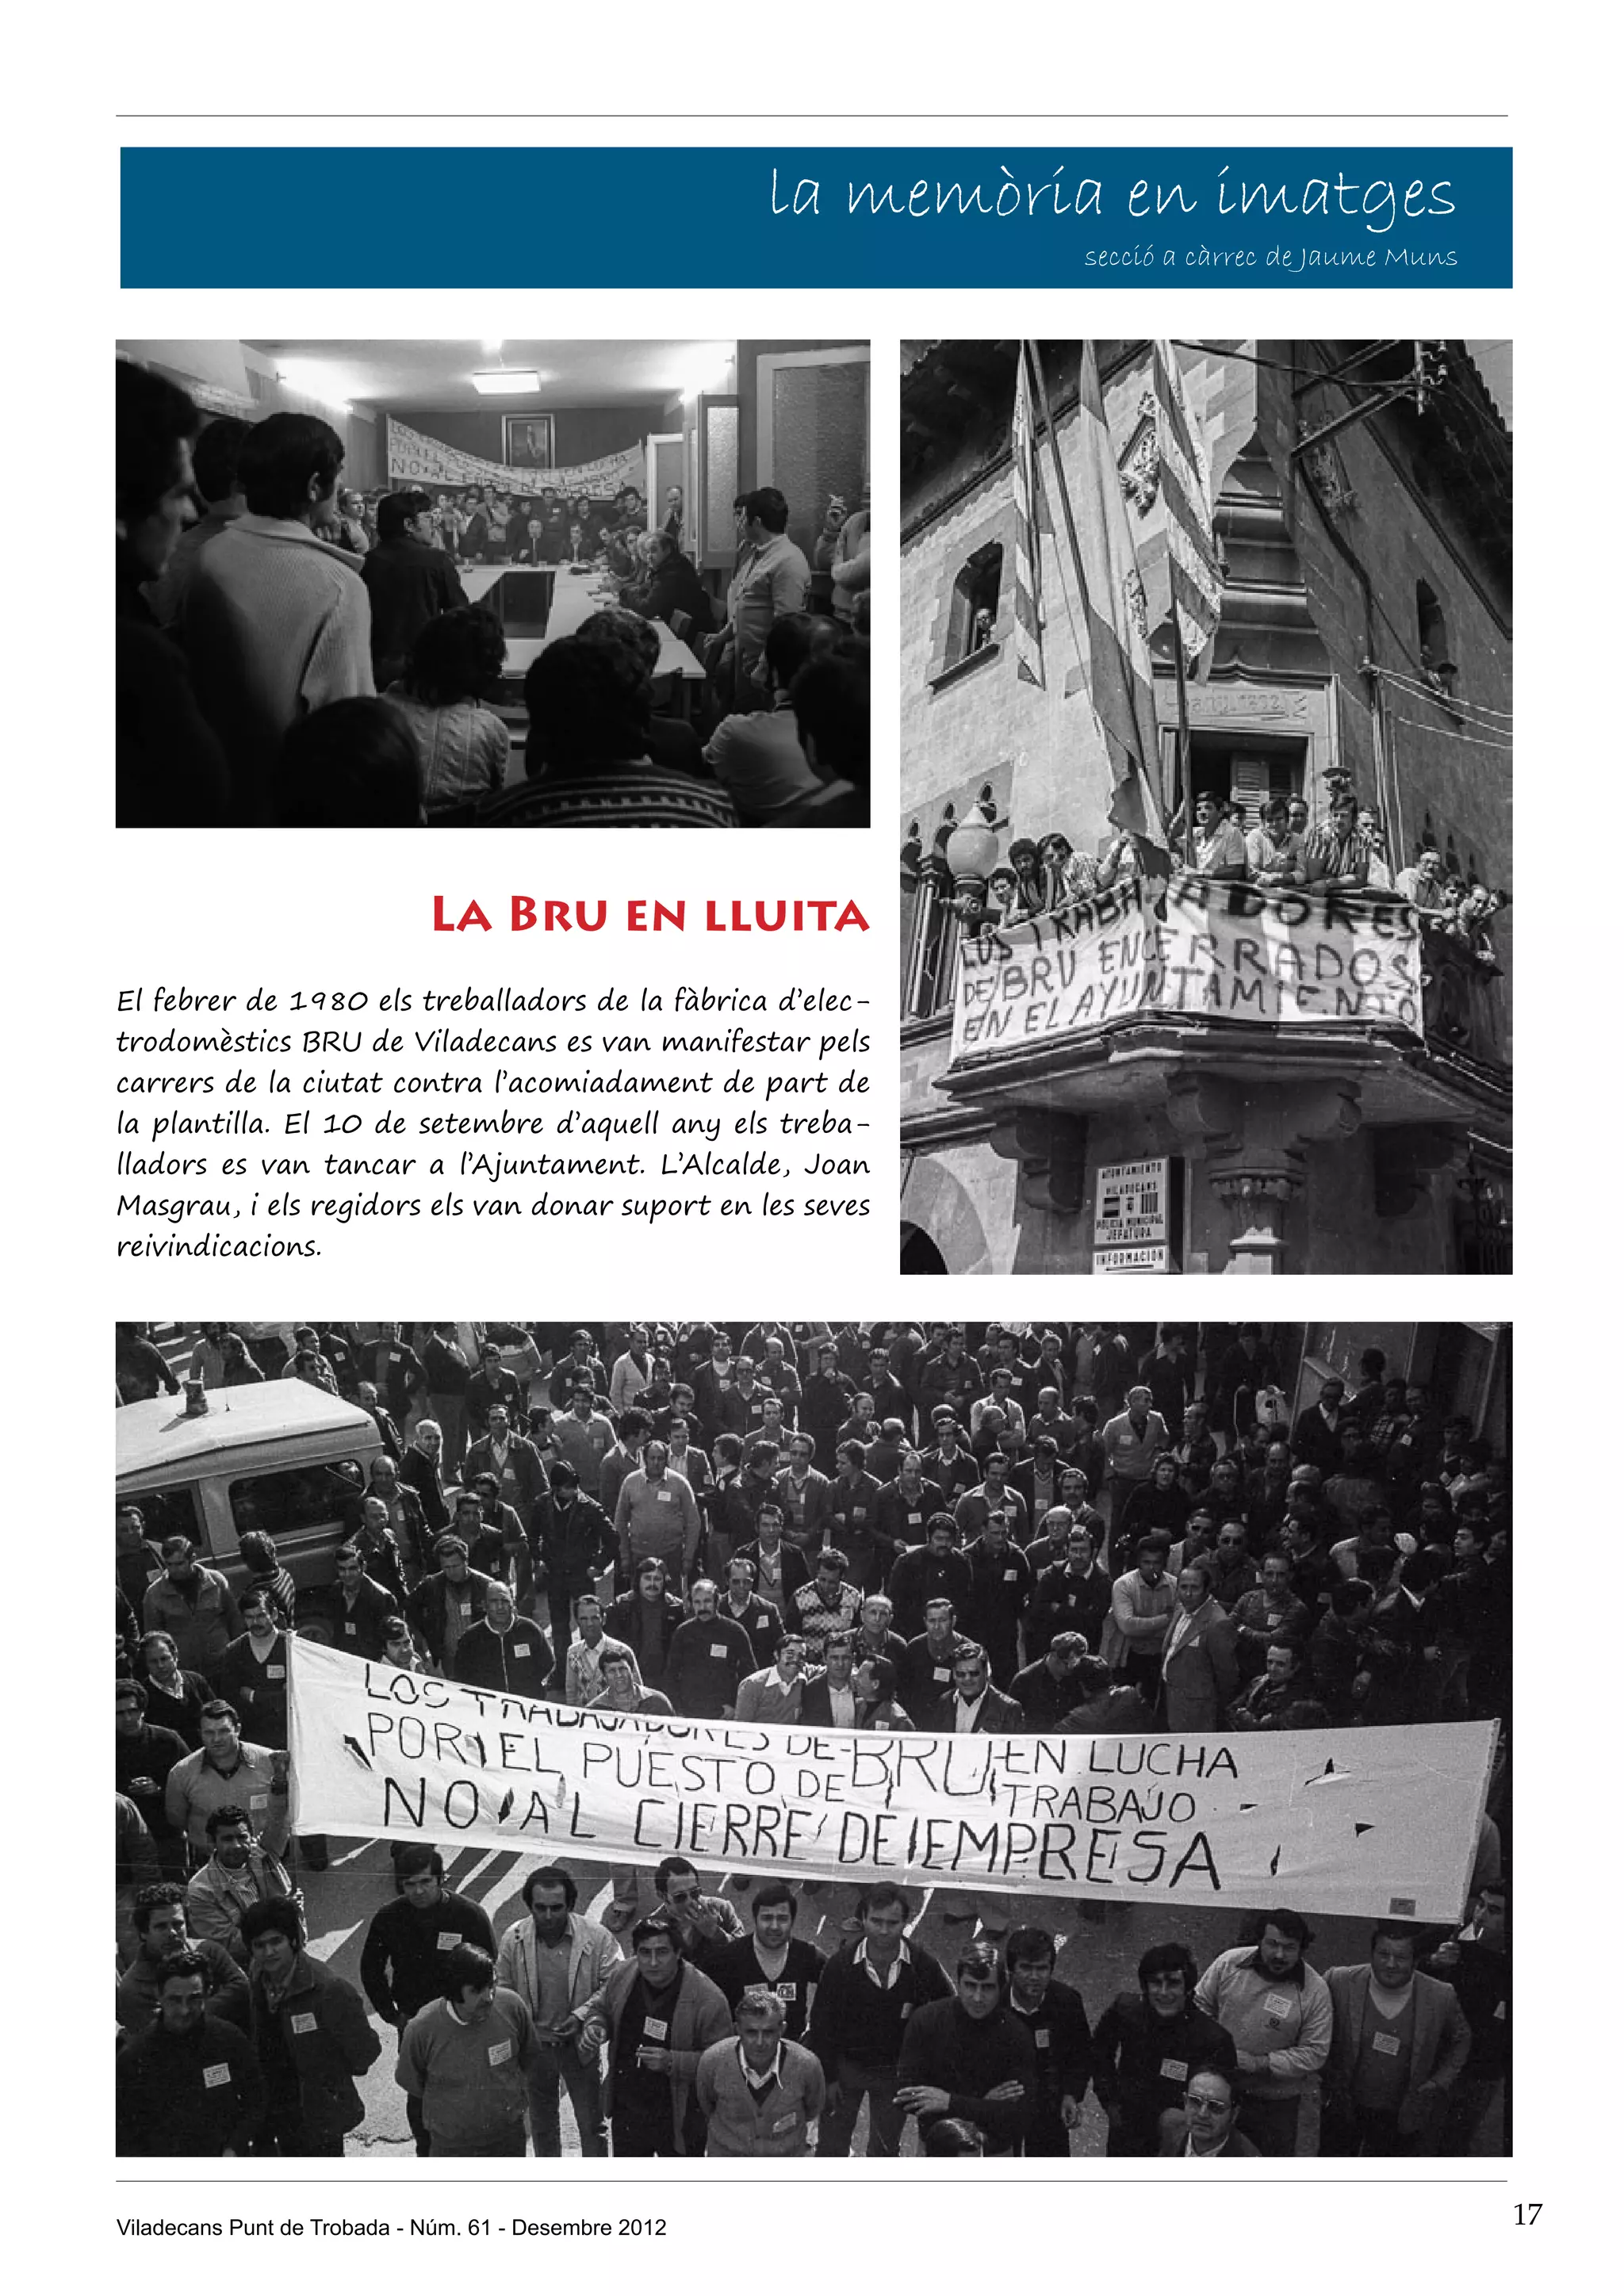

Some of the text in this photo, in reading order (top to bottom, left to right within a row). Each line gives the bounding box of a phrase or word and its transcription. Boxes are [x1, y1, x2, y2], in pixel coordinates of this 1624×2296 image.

[772, 165, 1456, 233] la memòria en imatges
[1084, 243, 1458, 273] secció a càrrec de Jaume Muns
[391, 457, 420, 476] NO
[960, 932, 1014, 971] LOS
[963, 922, 1419, 1009] DE BRU ENCERRADOS
[117, 985, 870, 1012] El febrer de 1980 els treballadors de la fàbrica d’elec-
[963, 965, 1418, 1042] EN EL AYUNTAMIENTO
[116, 1027, 871, 1061] trodomèstics BRU de Viladecans es van manifestar pels
[117, 1069, 870, 1102] carrers de la ciutat contra l’acomiadament de part de
[117, 1108, 870, 1142] la plantilla. El 10 de setembre d’aquell any els treba-
[117, 1150, 871, 1183] lladors es van tancar a l’Ajuntament. L’Alcalde, Joan
[117, 1191, 871, 1225] Masgrau, i els regidors els van donar suport en les seves
[117, 1232, 321, 1257] reivindicacions.
[364, 1662, 450, 1709] LOS
[1089, 1739, 1239, 1779] LUCHA
[367, 1712, 1197, 1824] POR EL PUESTO DE TRABAJO
[385, 1776, 1223, 1892] NO AL CIERRE DE EMPRESA
[116, 2218, 223, 2237] Viladecans
[230, 2218, 274, 2236] Punt
[280, 2218, 304, 2237] de
[309, 2218, 390, 2236] Trobada
[411, 2218, 461, 2237] Núm.
[468, 2218, 489, 2237] 61
[512, 2218, 612, 2237] Desembre
[618, 2218, 667, 2237] 2012
[1514, 2203, 1544, 2225] 17
